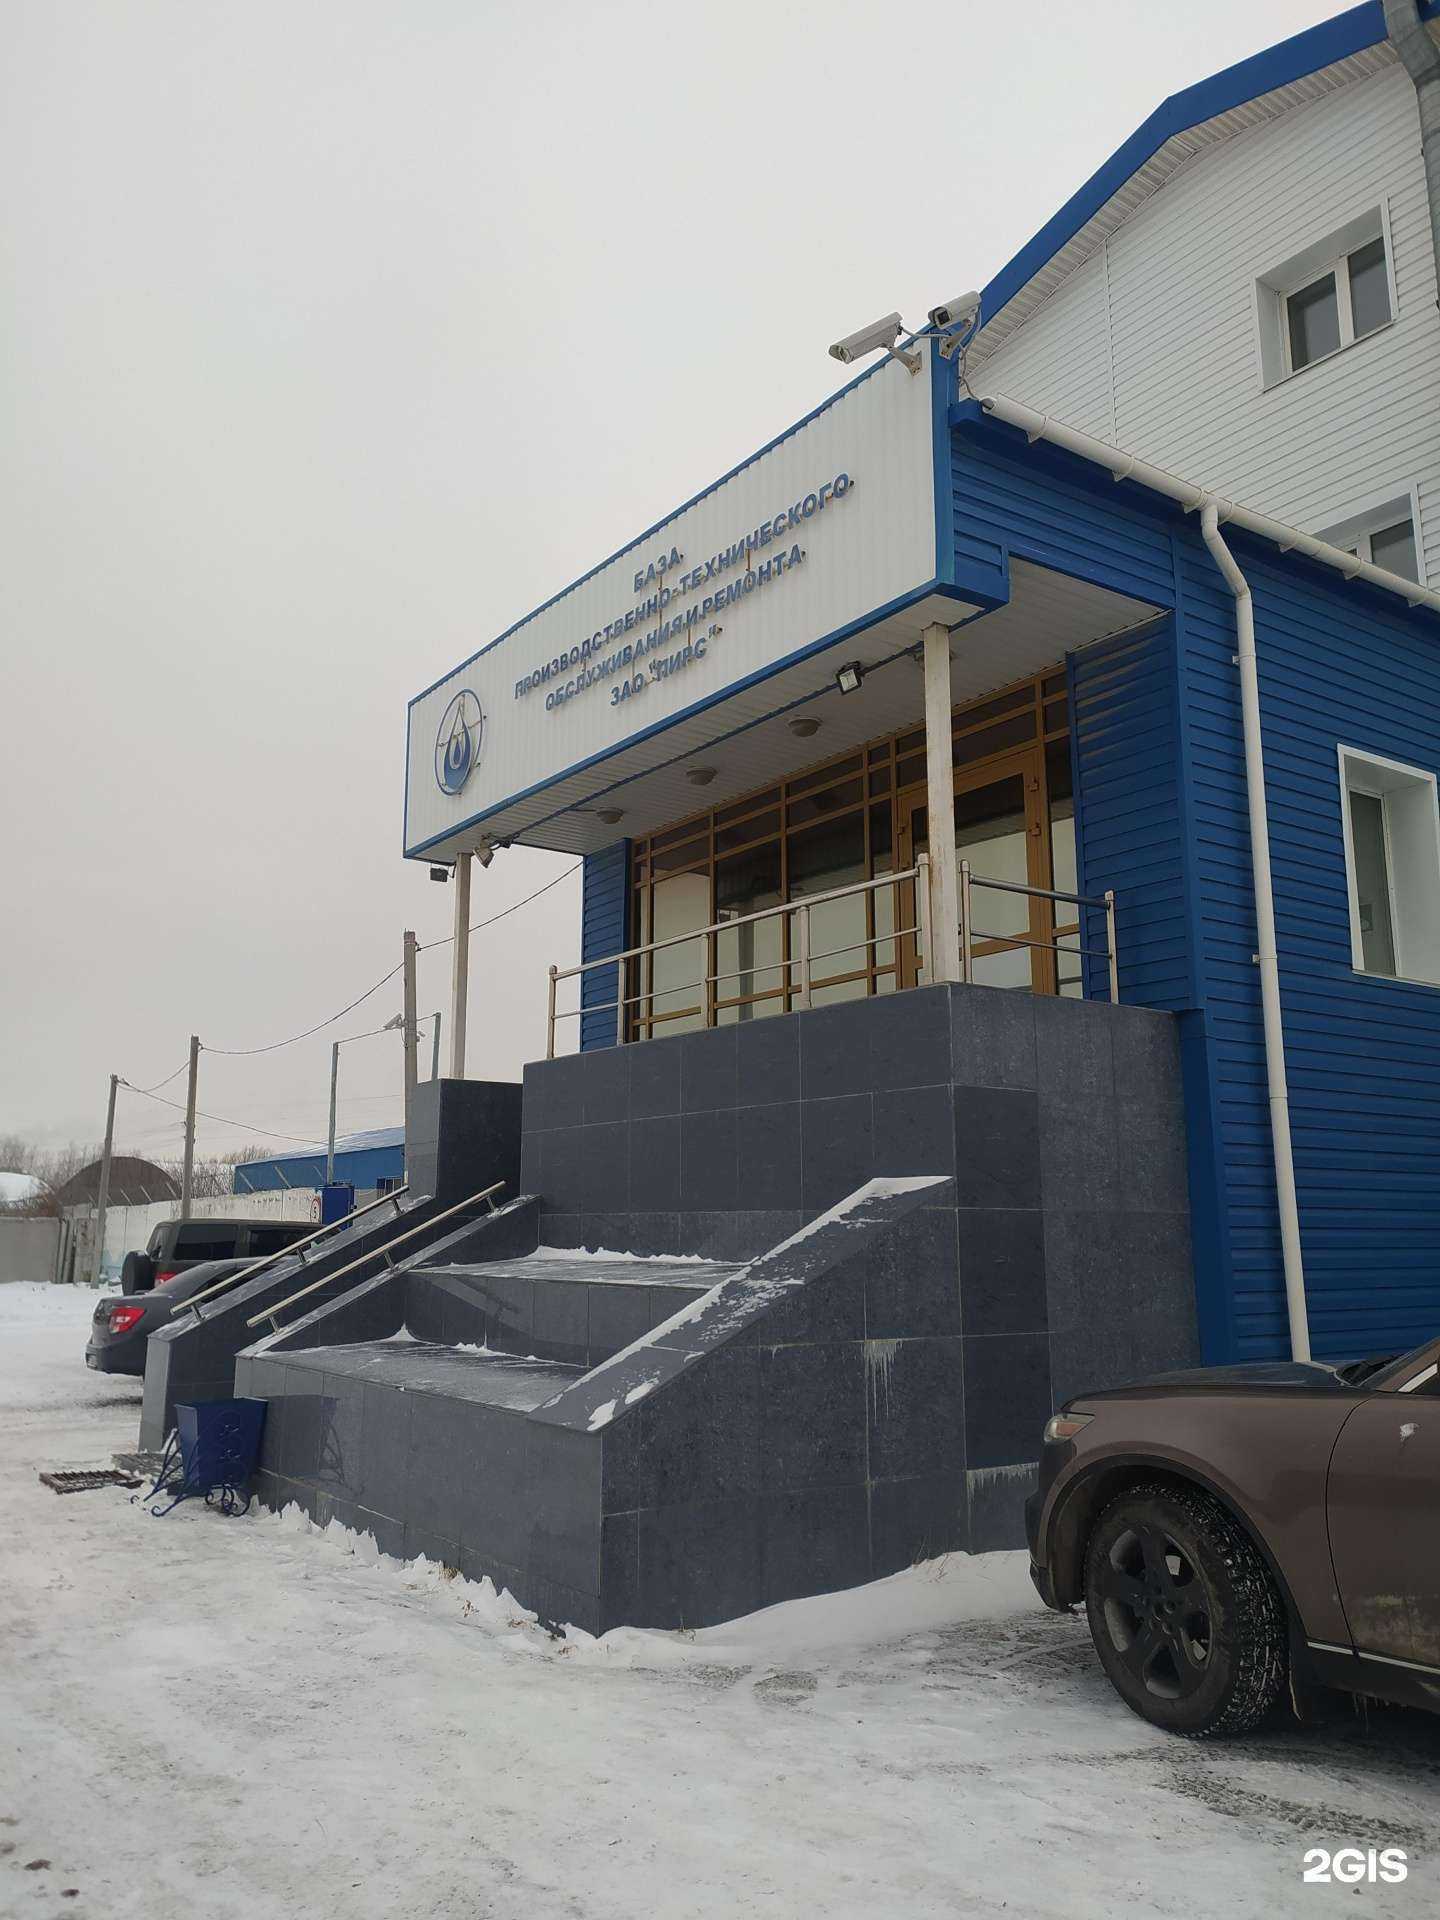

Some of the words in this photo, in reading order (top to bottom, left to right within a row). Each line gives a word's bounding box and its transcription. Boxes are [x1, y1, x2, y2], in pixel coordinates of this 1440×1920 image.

[514, 473, 850, 700] ПРОИЗВОДСТВЕННО-ТЕХНИЧЕСКОГО
[633, 546, 681, 593] БАЗА
[545, 614, 683, 711] ОБСЛУЖИВАНИЯ
[686, 605, 699, 628] И
[701, 543, 803, 620] РЕМОНТА
[610, 672, 645, 706] ЗАО
